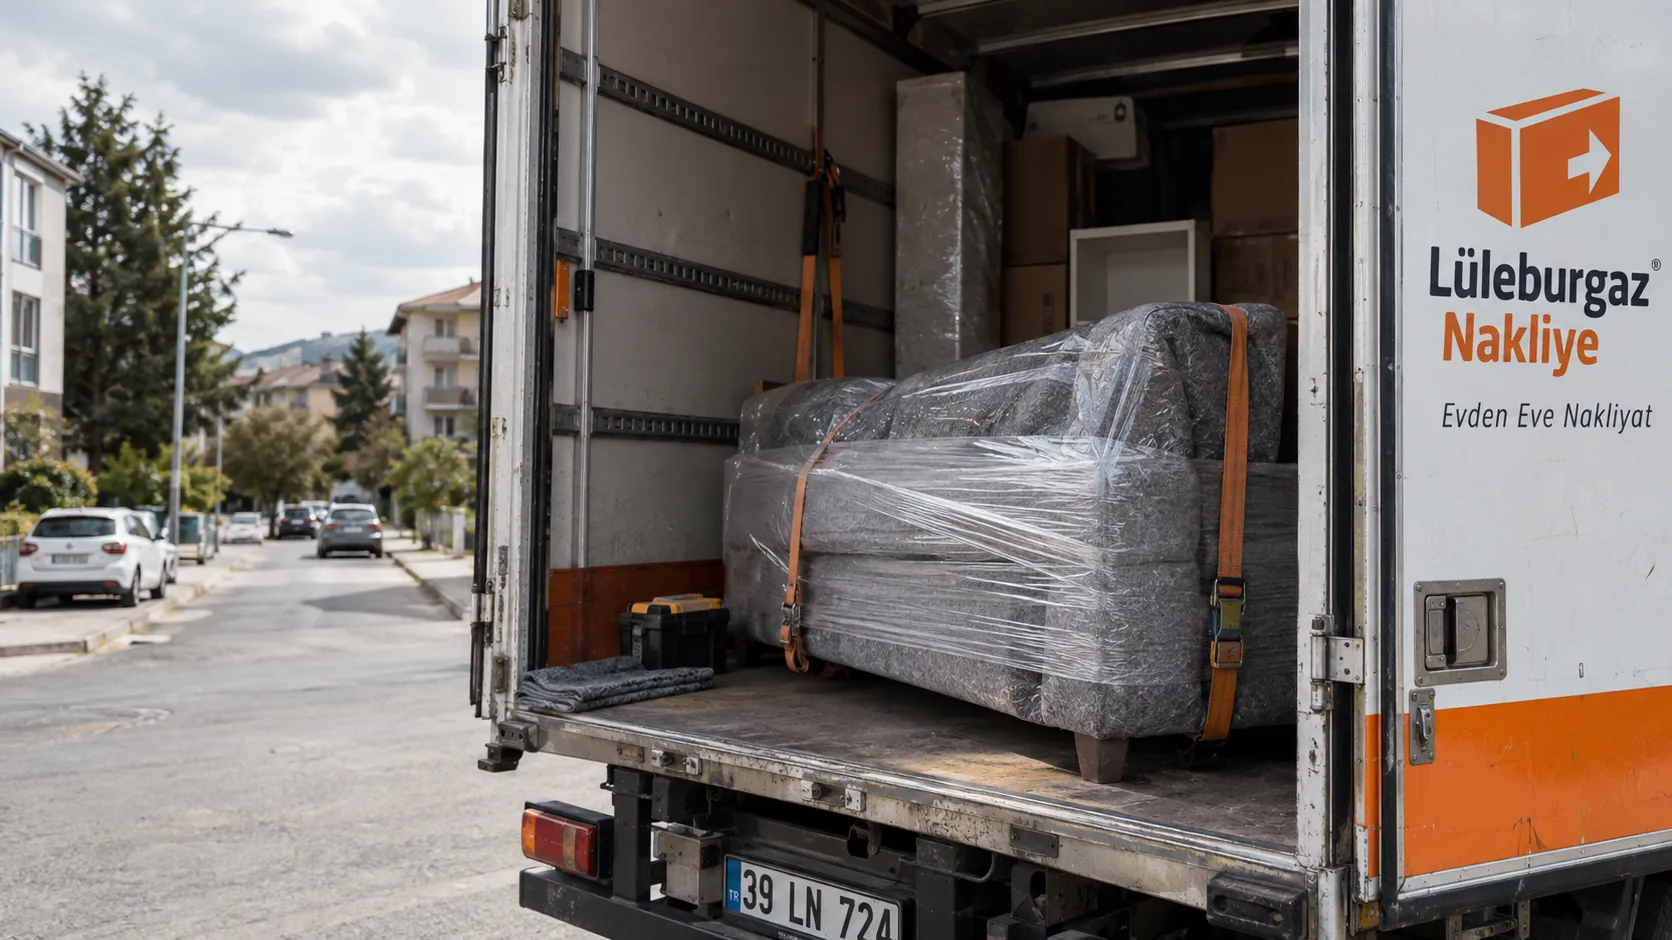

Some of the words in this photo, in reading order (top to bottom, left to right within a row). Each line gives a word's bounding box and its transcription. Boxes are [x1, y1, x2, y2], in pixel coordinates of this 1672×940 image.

[1429, 246, 1649, 318] Lüleburgaz
[1443, 311, 1599, 377] Nakliye
[1442, 402, 1507, 428] Evden
[1517, 402, 1554, 428] Eve
[1563, 402, 1653, 434] Nakliyat
[728, 889, 739, 903] TR
[743, 869, 773, 915] 39
[789, 881, 822, 931] LN
[839, 895, 893, 940] 724
